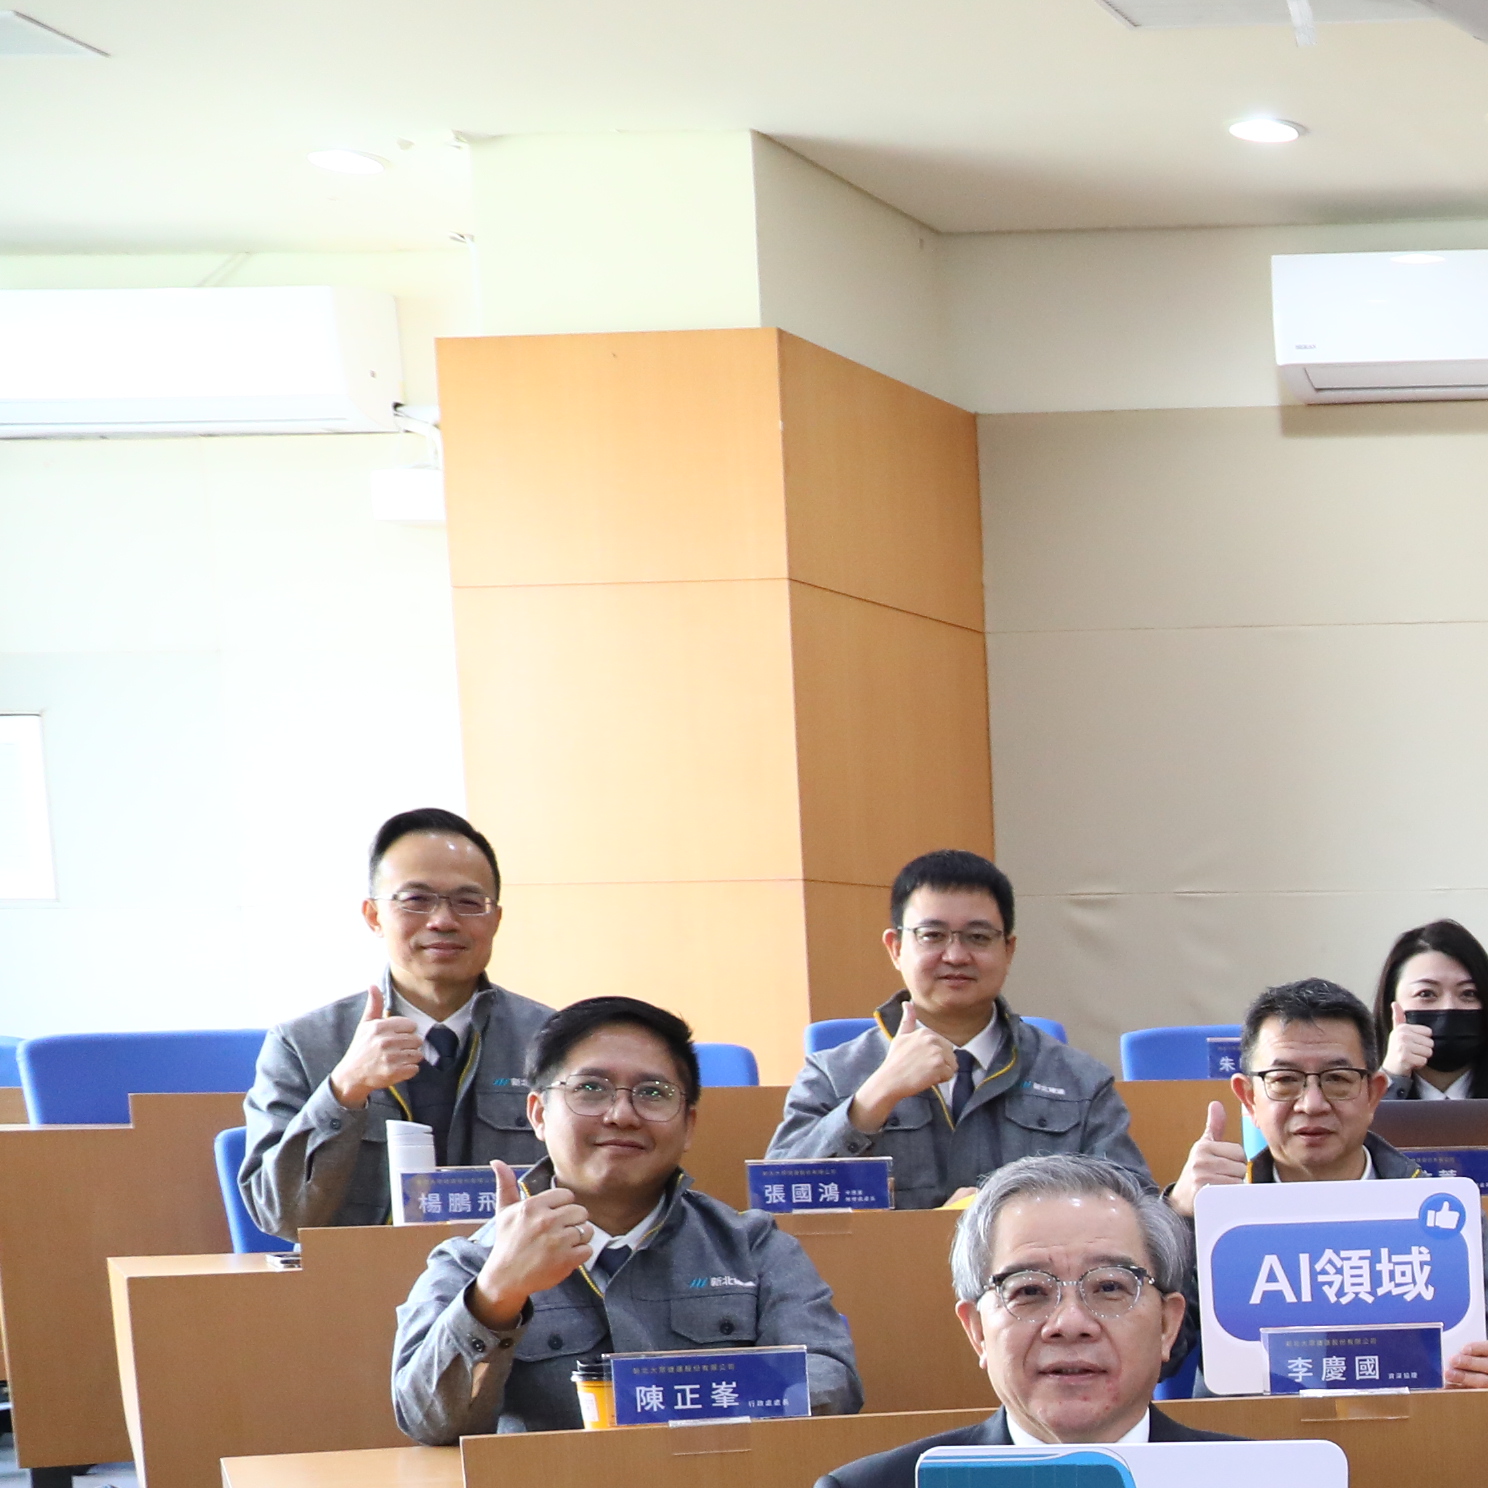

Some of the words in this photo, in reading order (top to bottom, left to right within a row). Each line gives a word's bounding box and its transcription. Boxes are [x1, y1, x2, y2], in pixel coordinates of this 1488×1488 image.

[418, 1191, 496, 1214] 楊鵬飛
[764, 1182, 840, 1204] 張國鴻
[1249, 1246, 1435, 1305] AI領域
[1287, 1355, 1380, 1383] 李慶國
[635, 1380, 740, 1413] 陳正峯
